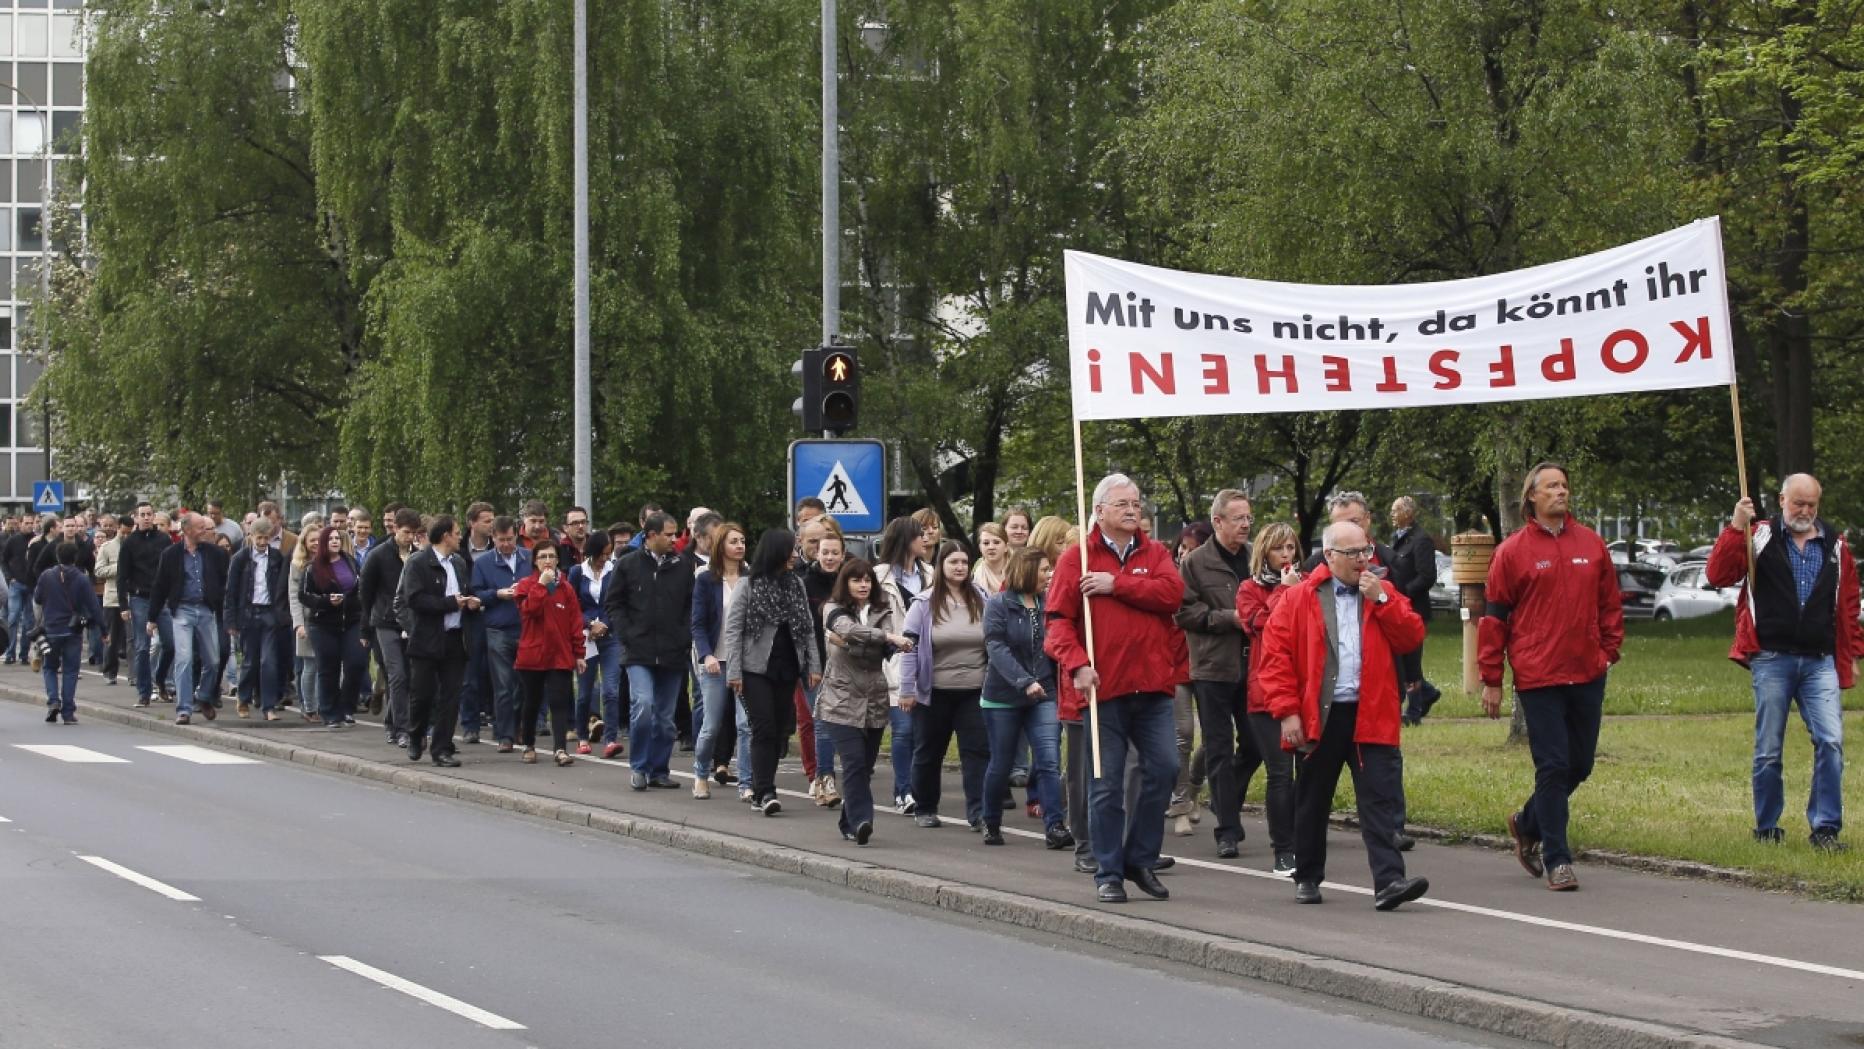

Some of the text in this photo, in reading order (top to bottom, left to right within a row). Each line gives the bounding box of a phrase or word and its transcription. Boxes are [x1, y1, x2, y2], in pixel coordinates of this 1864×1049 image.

[1085, 261, 1707, 344] Mit uns nicht, da könnt ihr
[1087, 316, 1713, 395] KOPFSTEHEN!
